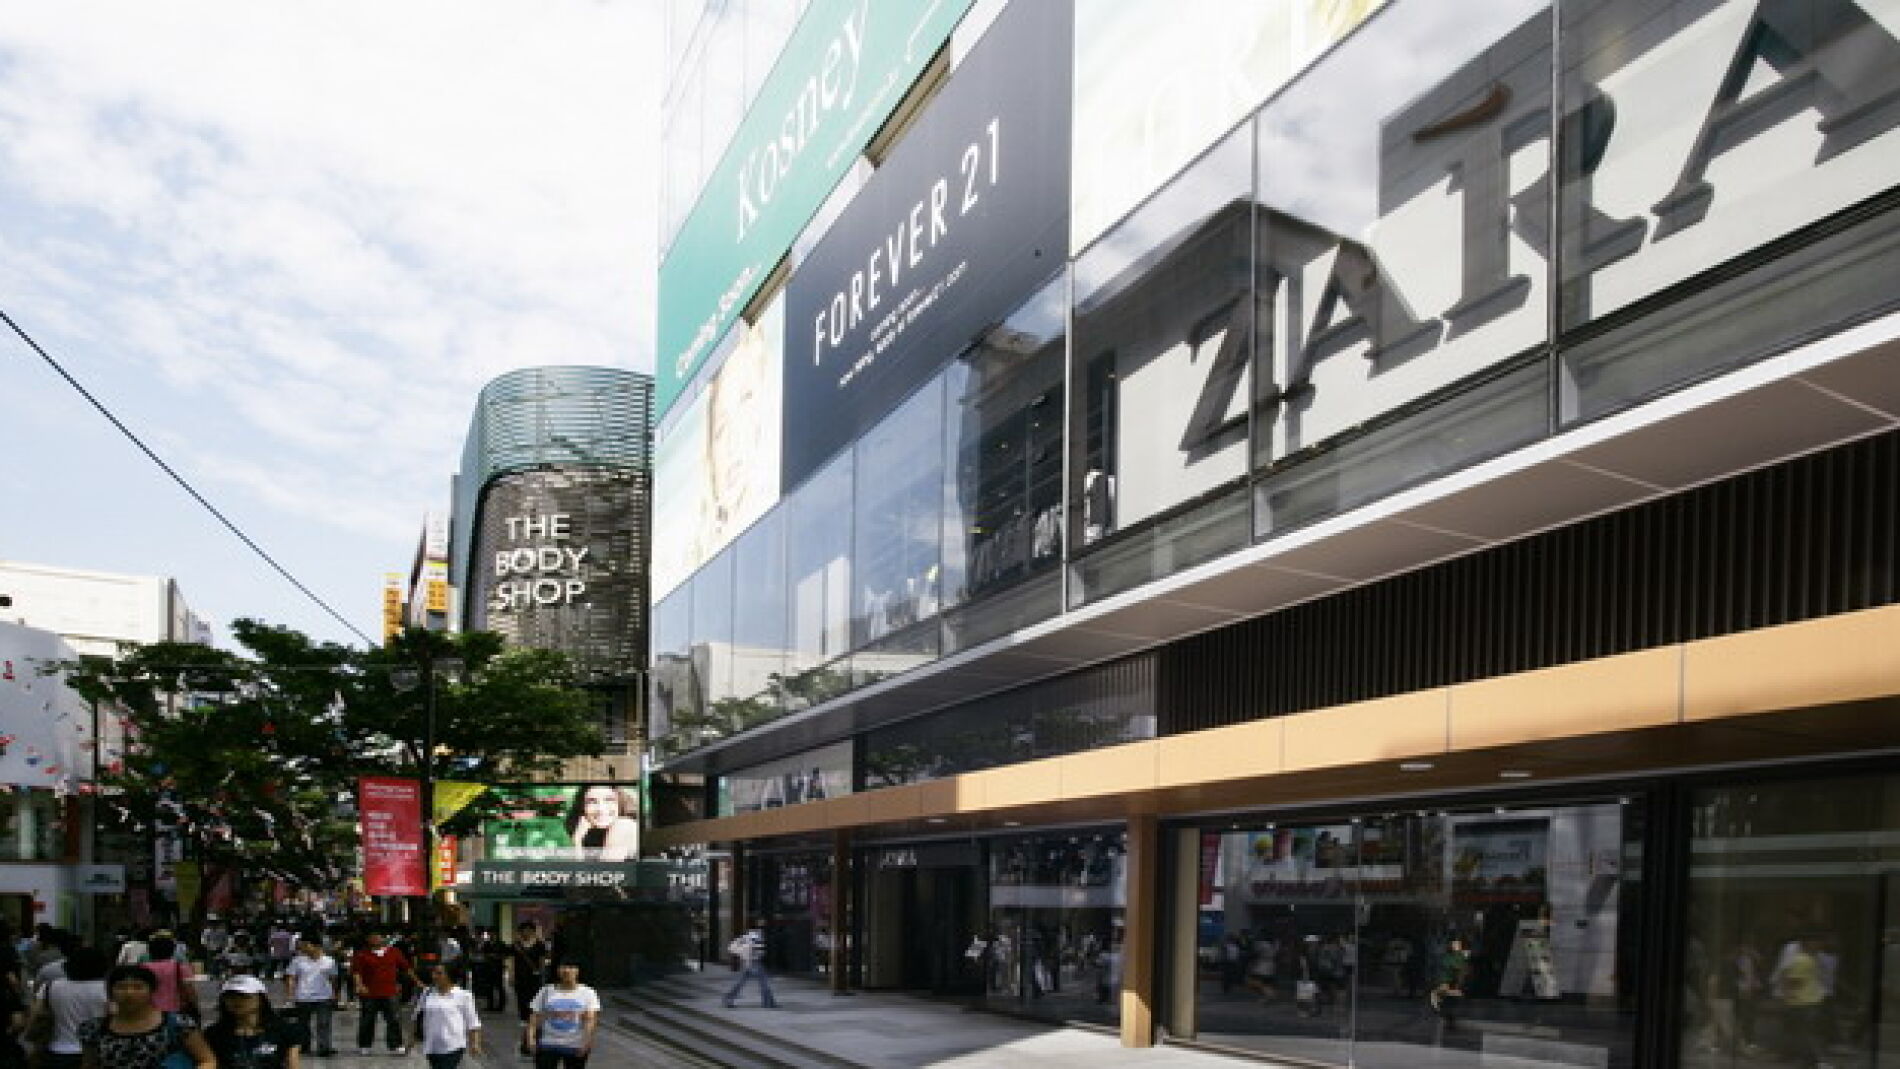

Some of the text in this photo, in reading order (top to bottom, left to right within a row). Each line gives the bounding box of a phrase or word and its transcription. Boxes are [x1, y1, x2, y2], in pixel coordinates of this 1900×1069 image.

[737, 0, 869, 246] Kosney
[814, 178, 948, 367] FOREVER
[959, 118, 1000, 216] 21
[1179, 0, 1900, 469] ZARA
[504, 514, 570, 541] THE
[495, 545, 589, 577] BODY
[490, 578, 587, 610] SHOP
[482, 870, 626, 887] THE BODY SHOP
